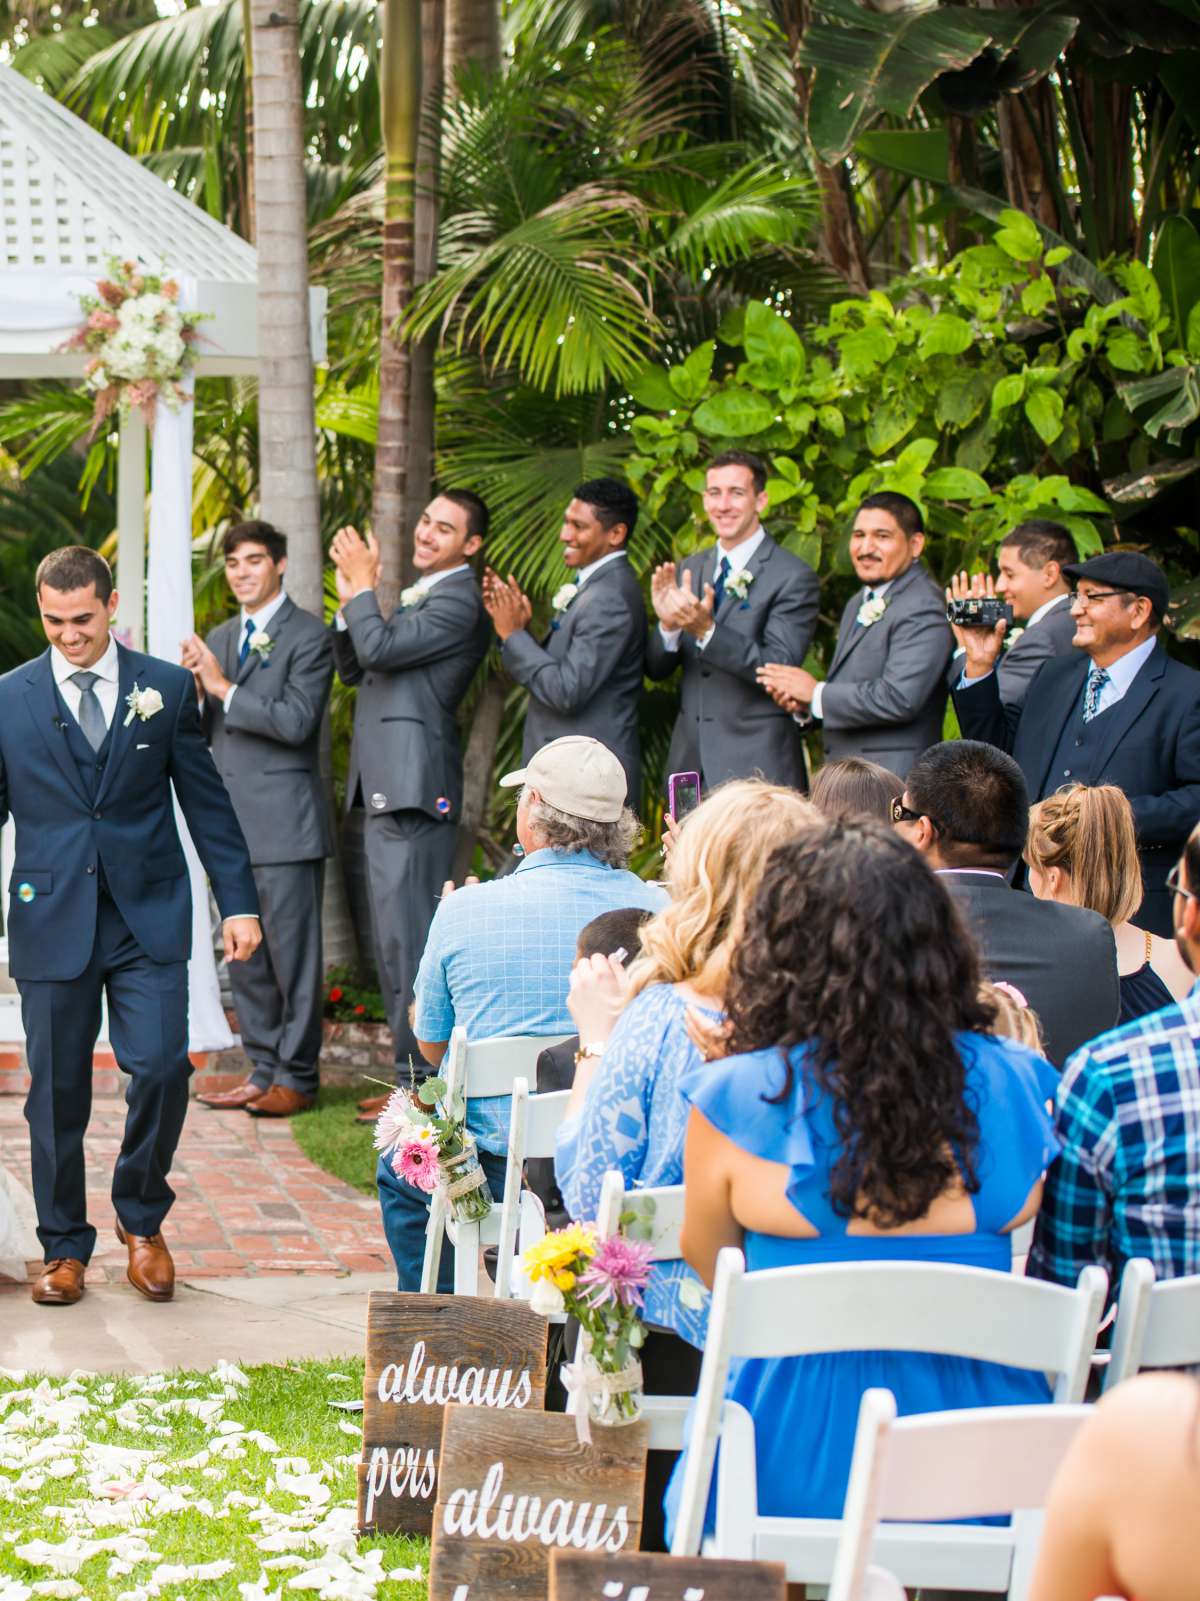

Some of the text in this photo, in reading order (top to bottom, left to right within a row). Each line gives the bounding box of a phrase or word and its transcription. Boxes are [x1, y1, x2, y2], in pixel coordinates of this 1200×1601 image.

[378, 1341, 532, 1409] always
[365, 1447, 436, 1523] pers
[443, 1462, 629, 1552] always
